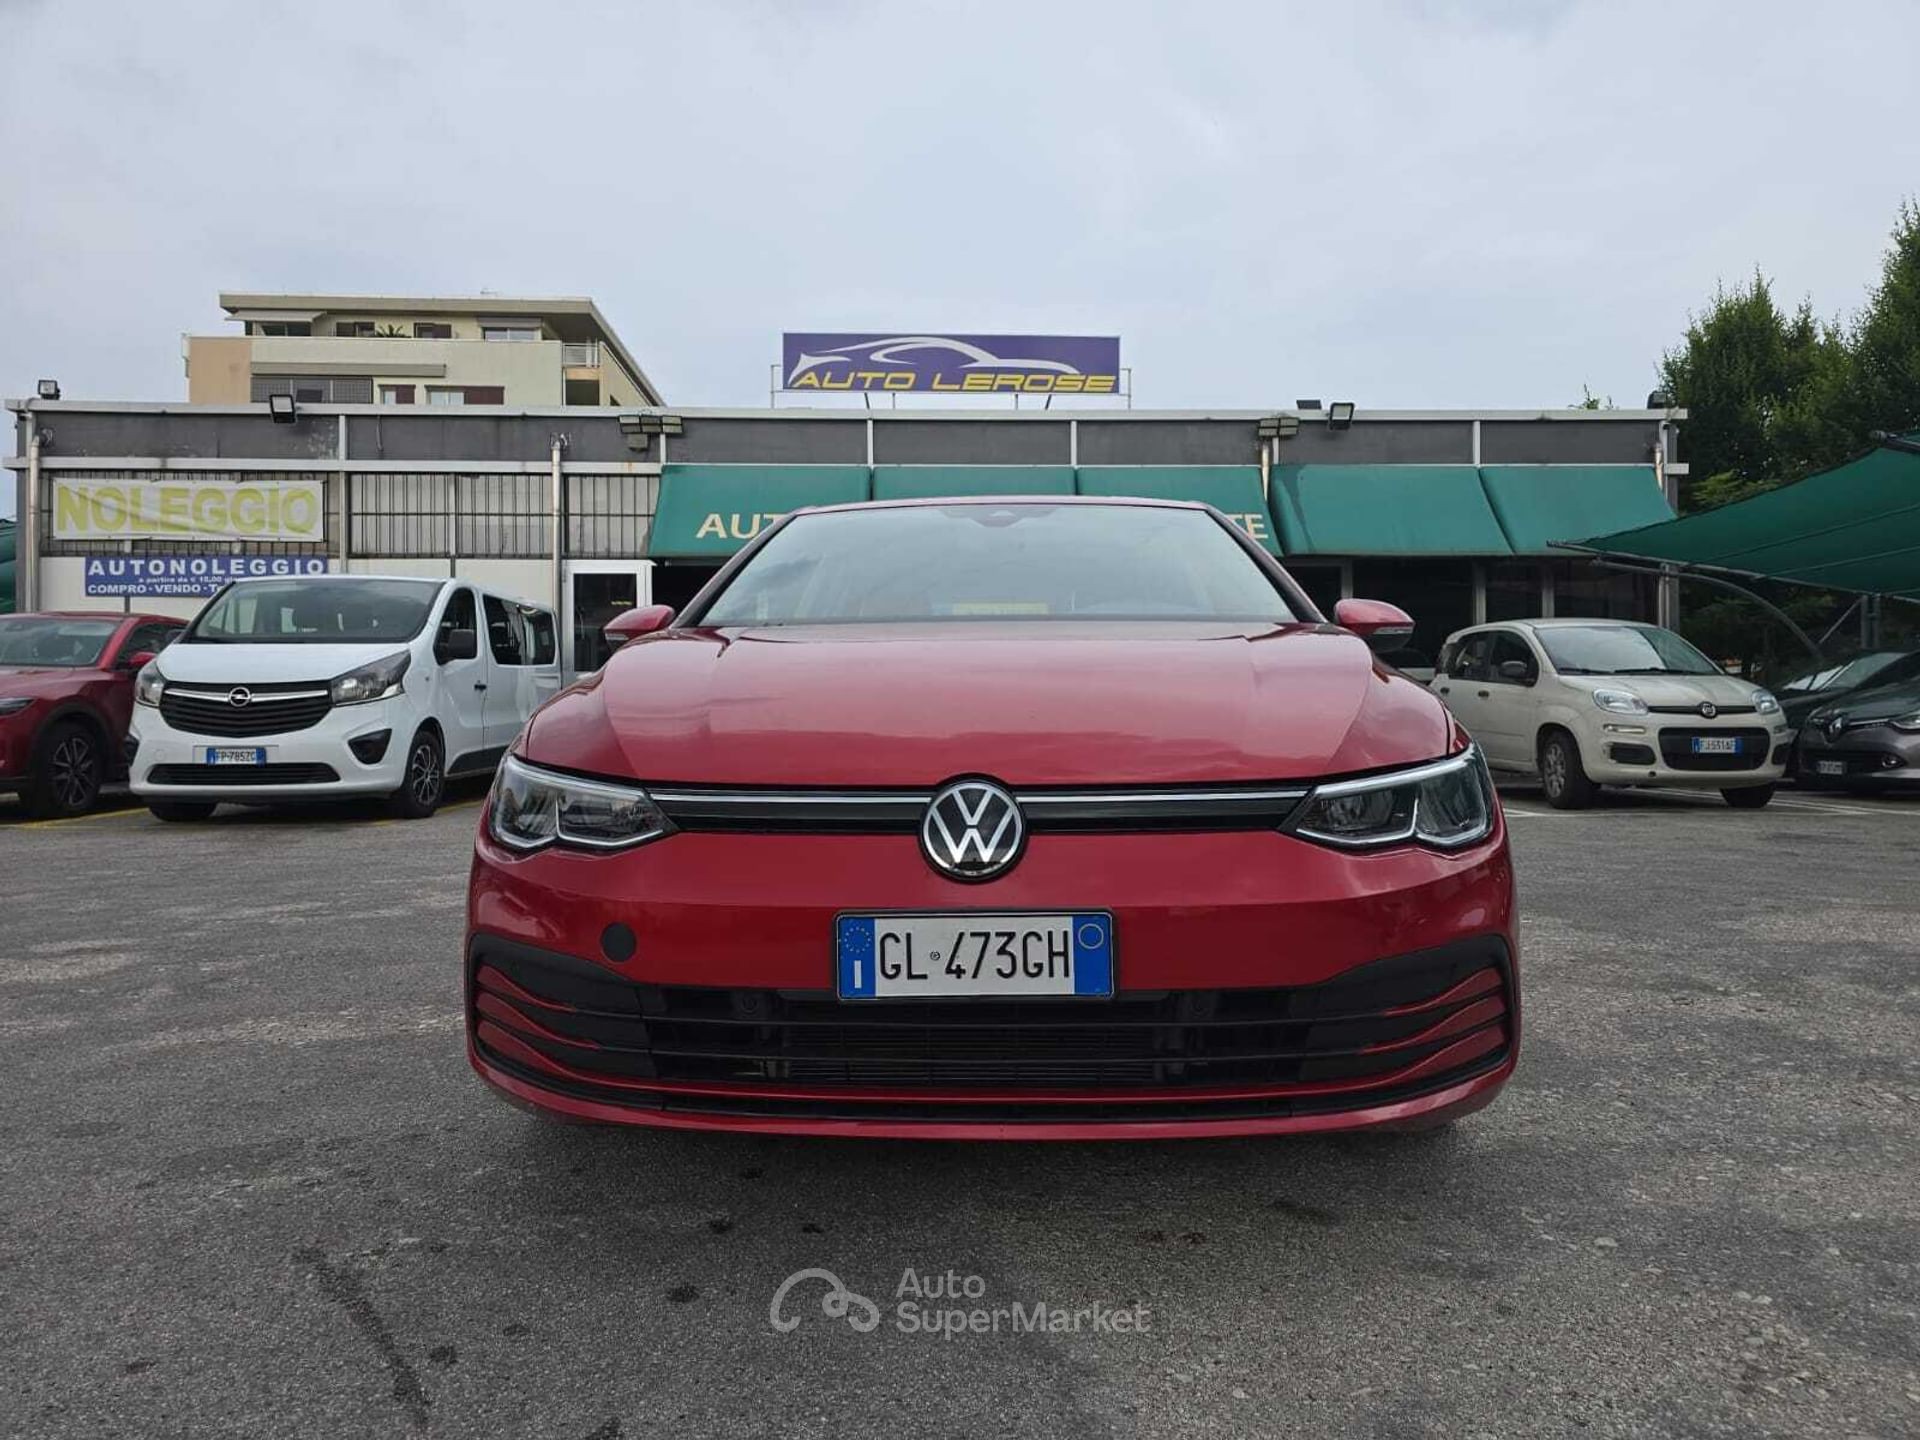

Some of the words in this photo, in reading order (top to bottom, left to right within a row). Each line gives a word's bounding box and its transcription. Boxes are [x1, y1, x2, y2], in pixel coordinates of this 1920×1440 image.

[794, 371, 916, 389] AUTO
[932, 372, 1117, 393] LEROSE
[57, 485, 318, 534] NOLEGGIO
[88, 558, 326, 576] AUTONOLEGGIO
[88, 584, 147, 594] COMPRO
[154, 583, 201, 593] VENDO
[879, 931, 928, 980] GL
[944, 930, 1070, 980] 473GH
